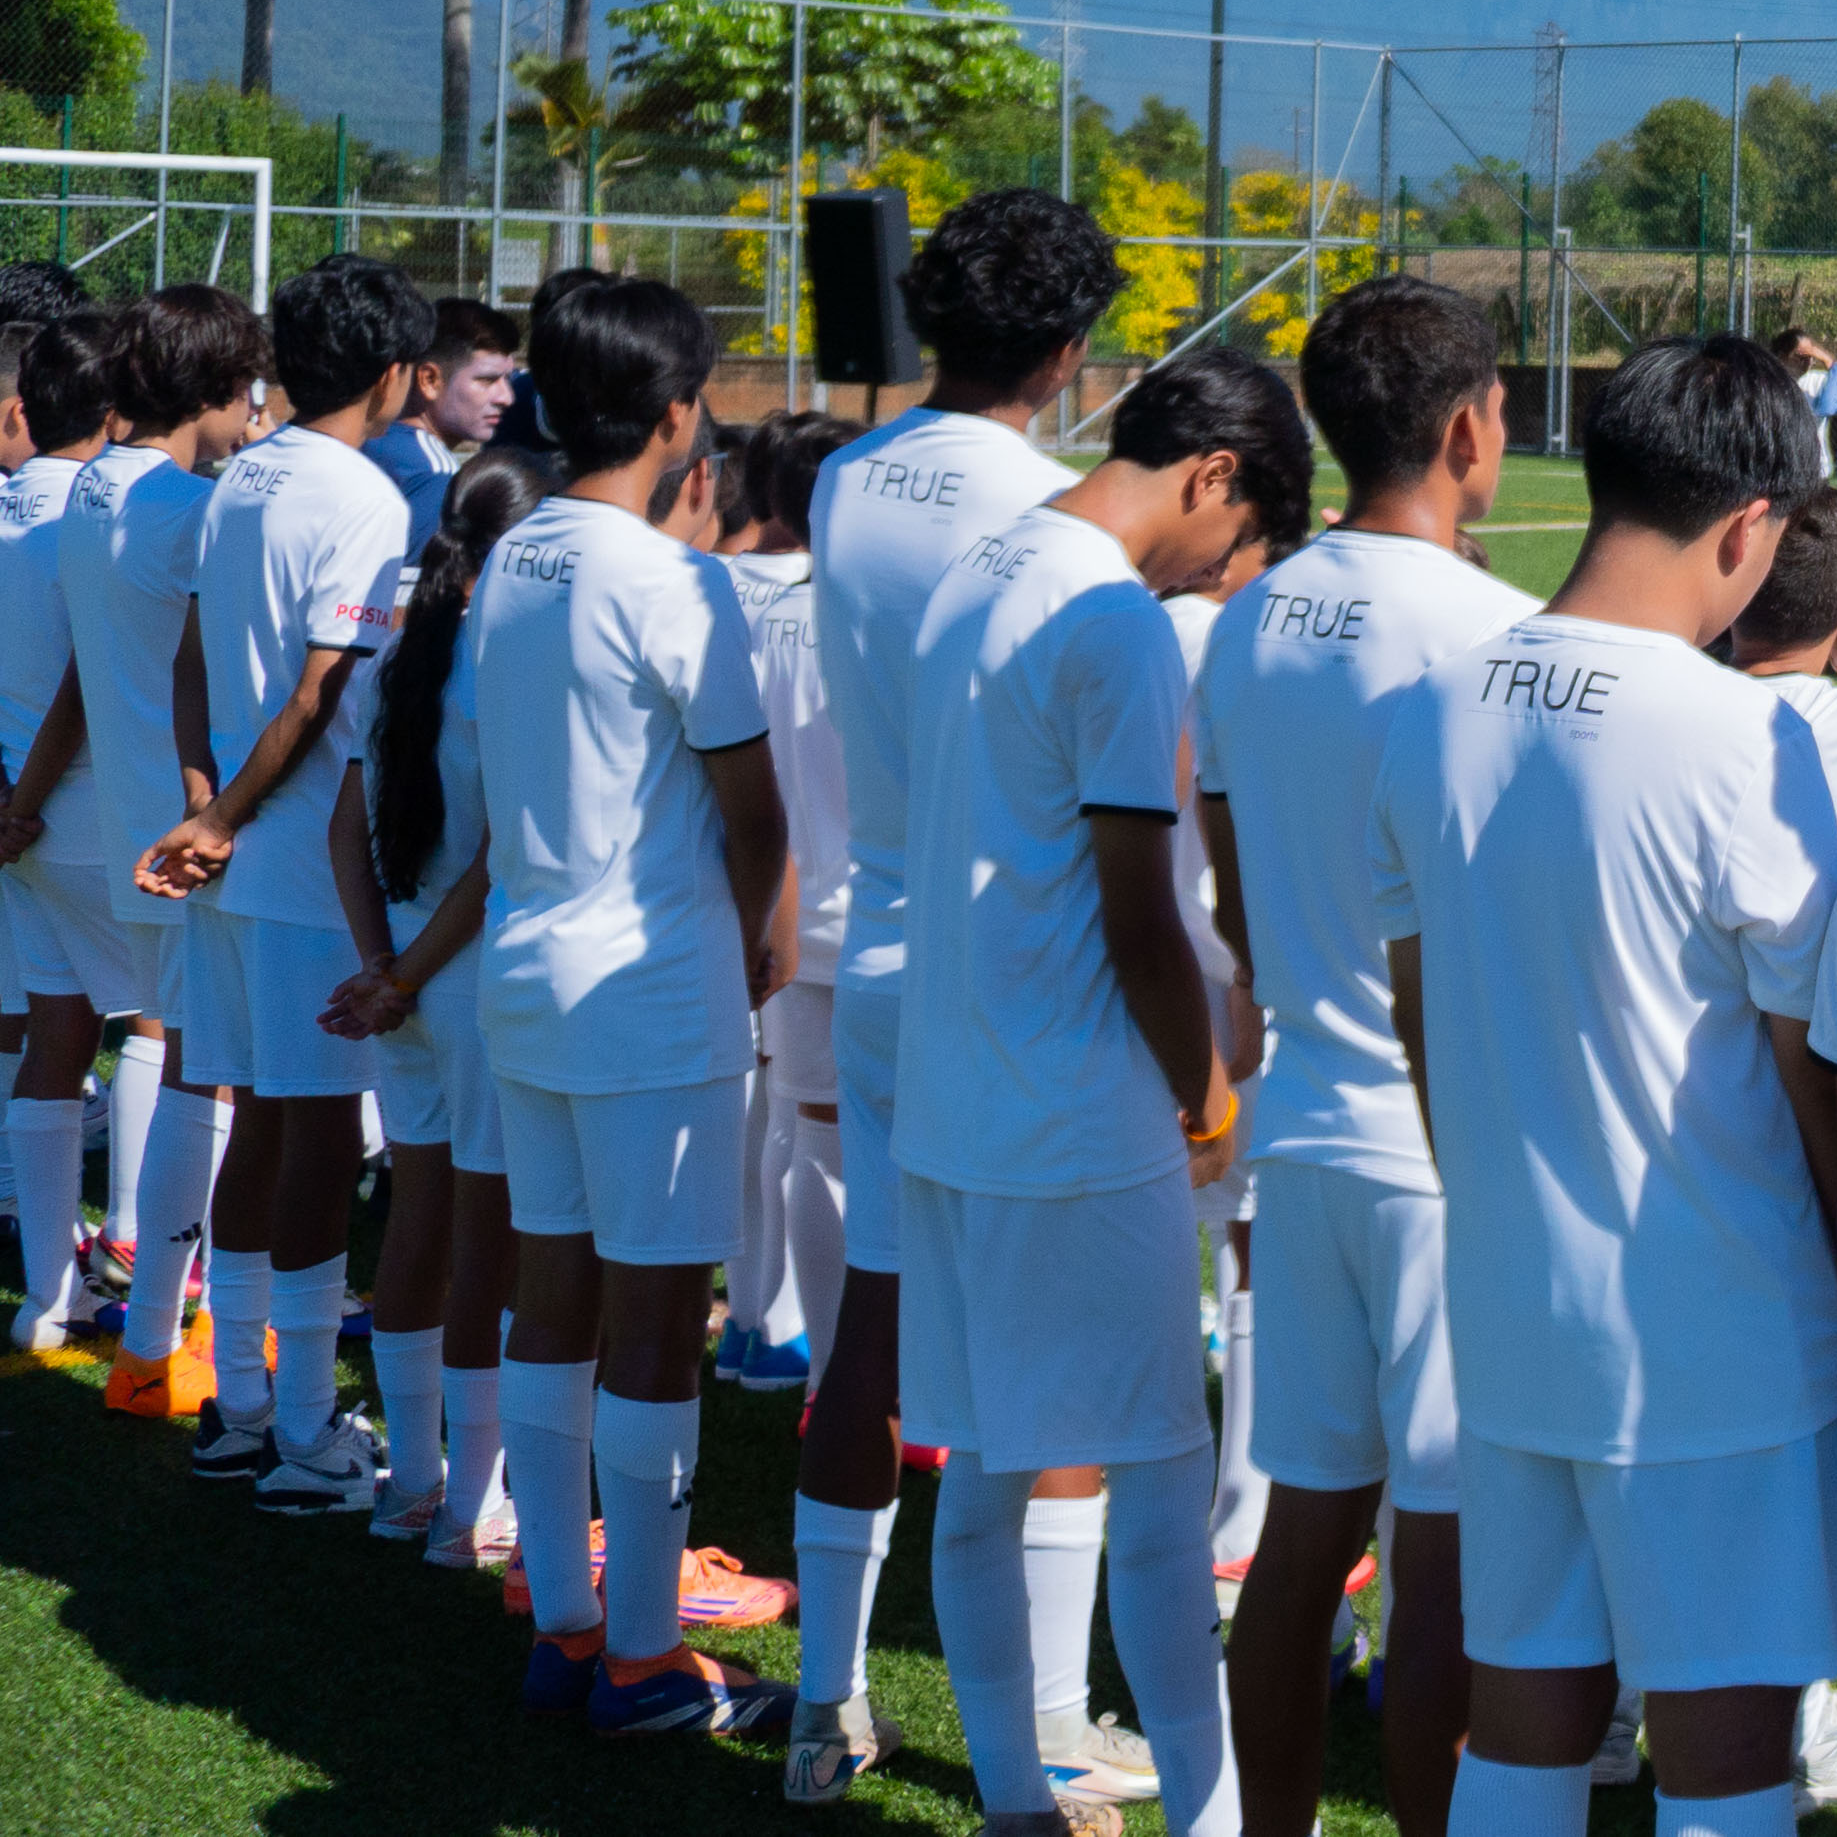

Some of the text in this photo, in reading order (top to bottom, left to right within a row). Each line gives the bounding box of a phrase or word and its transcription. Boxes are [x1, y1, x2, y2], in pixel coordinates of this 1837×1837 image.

[70, 473, 119, 508] TRUE
[229, 458, 292, 495] TRUE
[861, 459, 966, 507] TRUE
[503, 541, 582, 584] TRUE
[960, 536, 1038, 581] TRUE
[766, 619, 817, 648] TRU
[1261, 594, 1371, 641] TRUE
[1480, 660, 1620, 715] TRUE
[1569, 728, 1599, 742] sports
